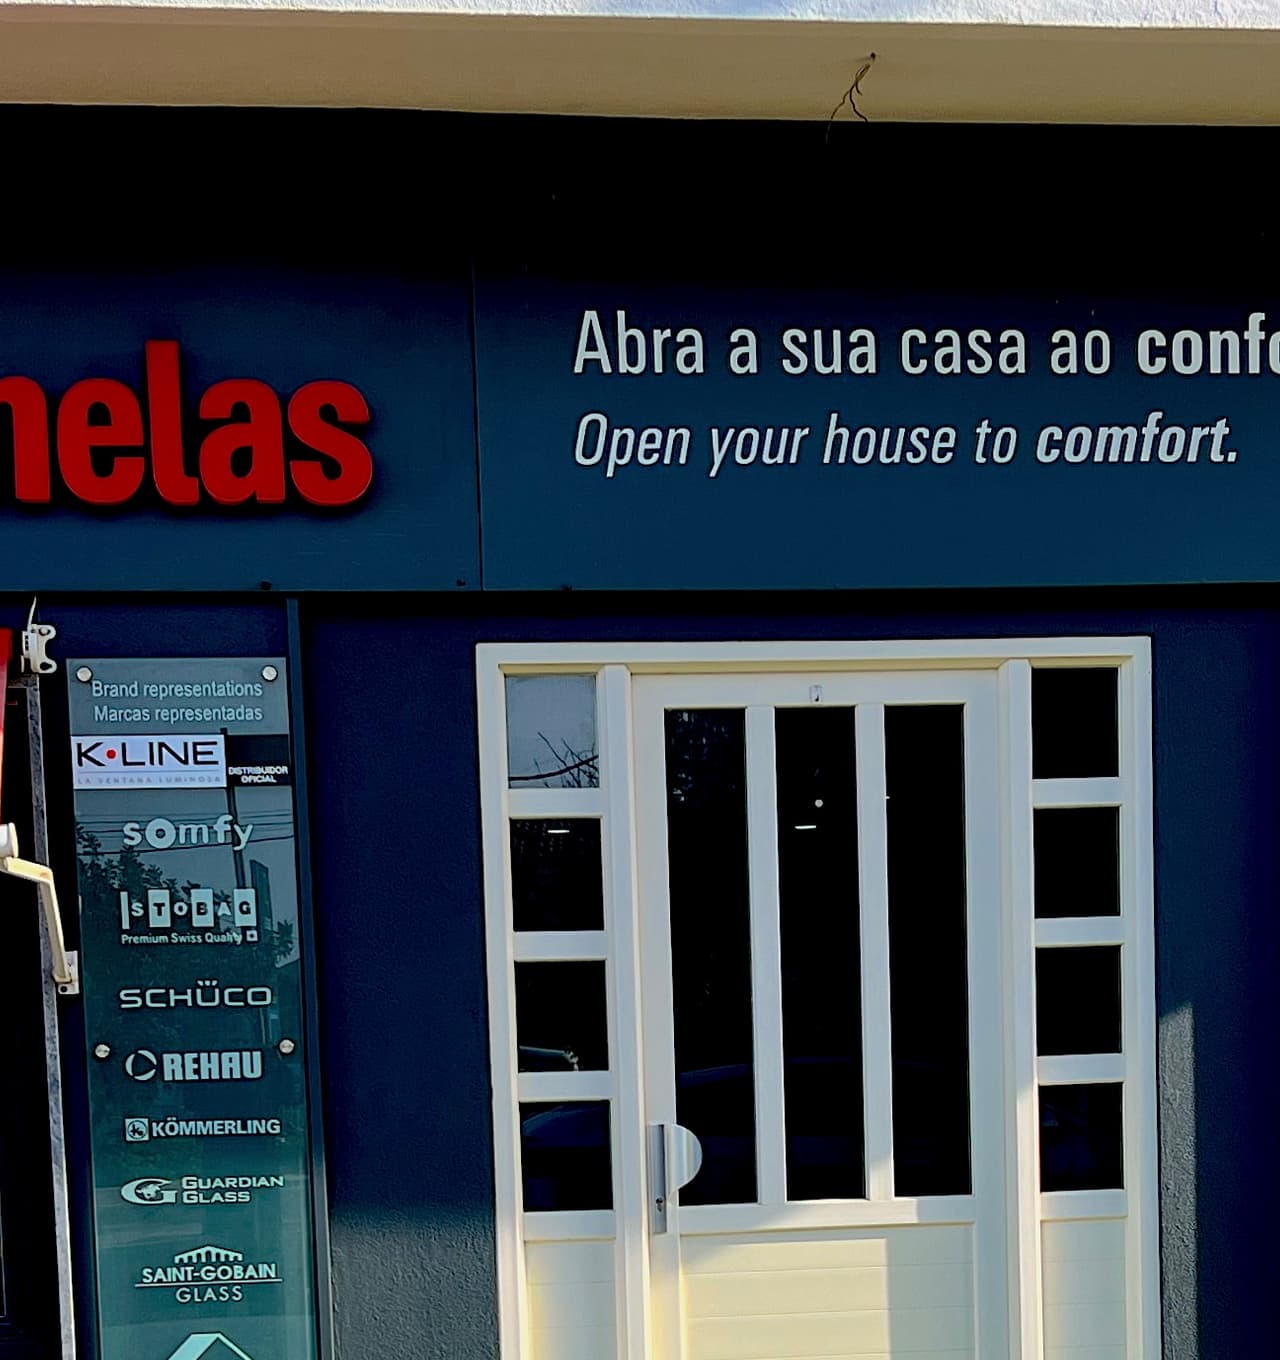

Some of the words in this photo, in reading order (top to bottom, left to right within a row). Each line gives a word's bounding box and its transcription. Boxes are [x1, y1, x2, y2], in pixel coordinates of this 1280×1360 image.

[573, 310, 704, 375] Abra
[729, 328, 758, 375] a
[782, 328, 876, 375] sua
[901, 329, 1026, 375] casa
[1050, 329, 1110, 374] ao
[575, 413, 691, 478] Open
[709, 427, 810, 478] your
[823, 412, 956, 464] house
[975, 419, 1017, 464] to
[1036, 411, 1238, 464] comfort.
[91, 680, 139, 698] Brand
[143, 679, 263, 701] representations
[94, 706, 150, 723] Marcas
[154, 704, 263, 724] representadas
[228, 766, 289, 776] DISTRIBUIDOR
[240, 774, 277, 784] OFICIAL
[122, 814, 254, 851] somfy
[121, 934, 169, 945] Premium
[170, 933, 202, 944] Swiss
[204, 932, 243, 945] Quality
[118, 979, 273, 1010] SCHÜCO
[162, 1050, 264, 1082] REHAU
[151, 1116, 281, 1137] KÖMMERLING
[182, 1190, 251, 1204] GLASS
[141, 1262, 278, 1284] SAINT-GOBAIN
[175, 1285, 244, 1304] GLASS
